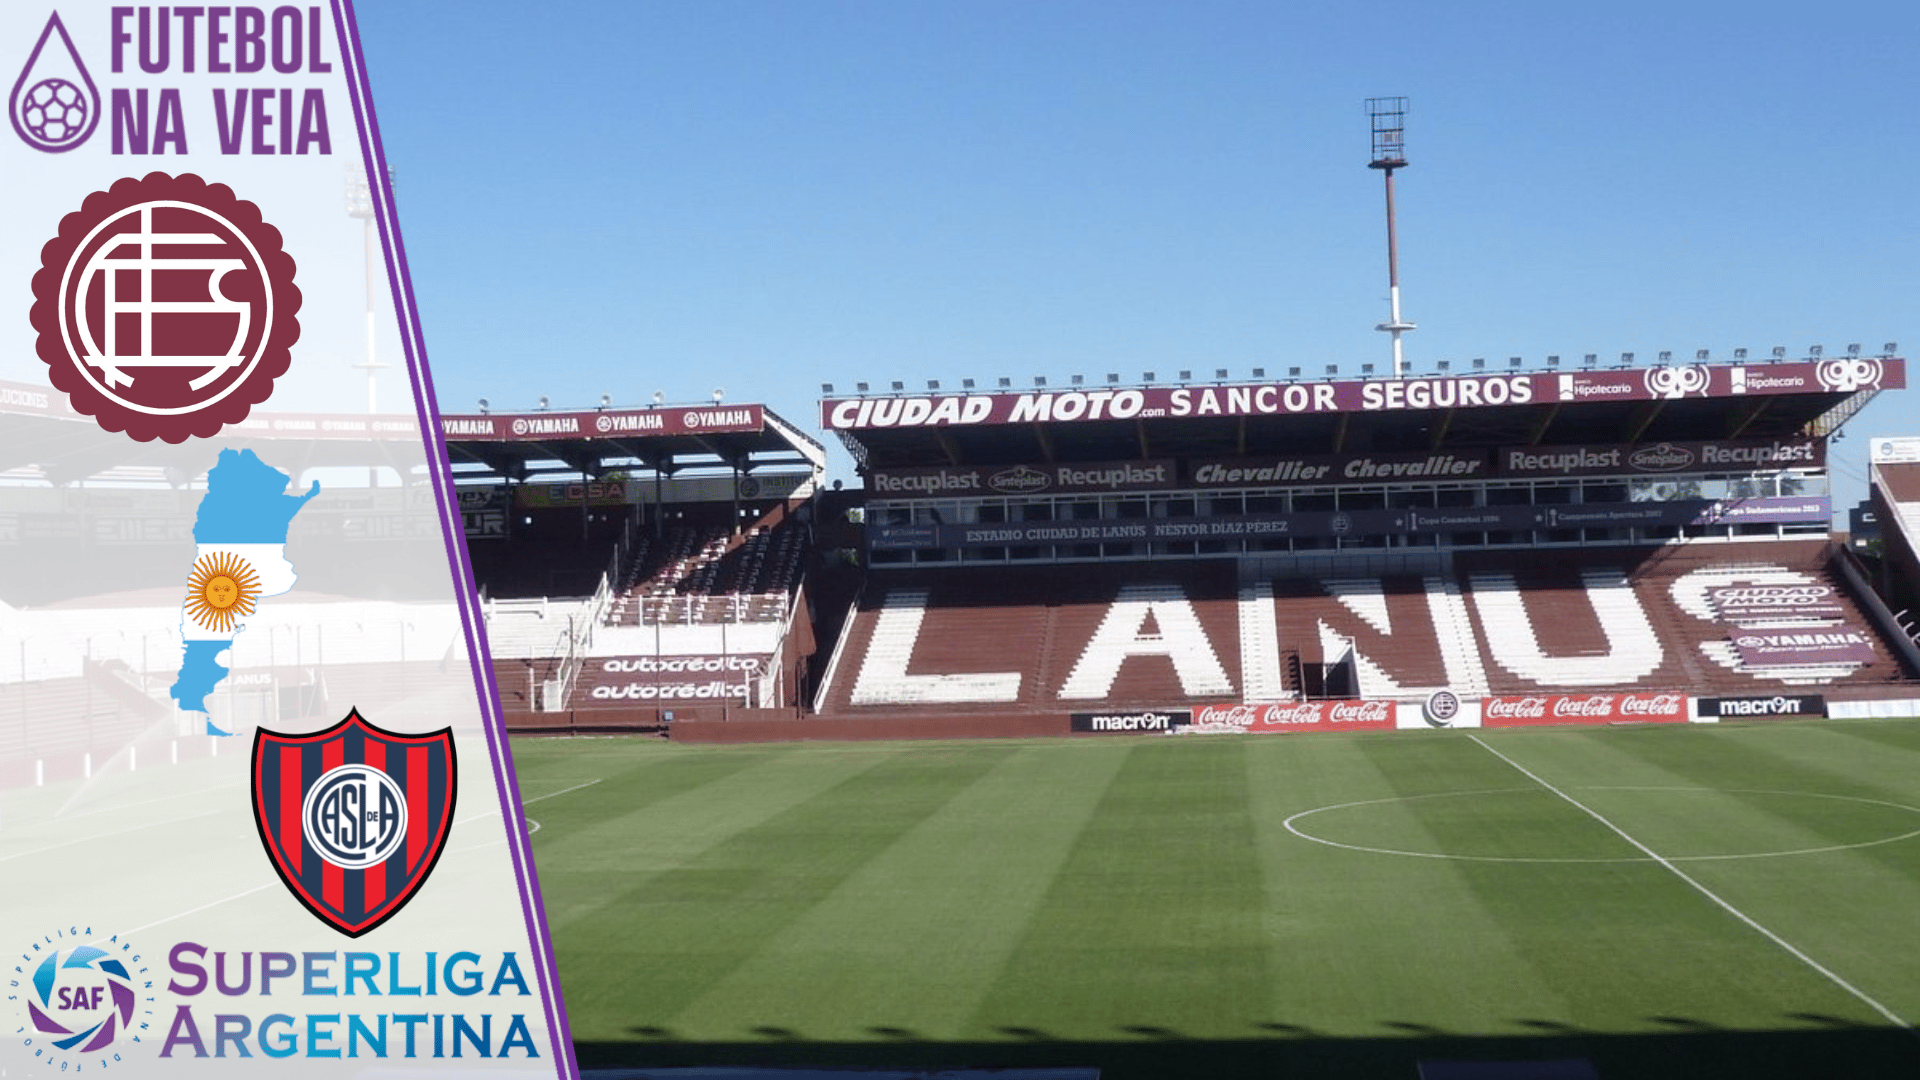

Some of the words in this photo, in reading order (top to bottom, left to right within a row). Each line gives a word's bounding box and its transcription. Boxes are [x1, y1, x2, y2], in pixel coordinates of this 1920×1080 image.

[1170, 384, 1338, 416] SANCOR
[1362, 376, 1532, 409] SEGUROS
[698, 411, 752, 427] YAMAHA
[830, 397, 993, 428] CIUDAD
[527, 418, 580, 434] YAMAHA
[612, 415, 664, 431] YAMAHA
[1509, 448, 1621, 473] Recuplast
[1702, 442, 1814, 472] Recuplast
[1057, 464, 1166, 488] Recuplast
[1195, 461, 1331, 484] Chevallier
[1344, 456, 1482, 479] Chevallier
[874, 470, 981, 494] Recuplast
[966, 529, 1023, 542] ESTADIO
[1026, 527, 1078, 541] CIUDAD
[1082, 526, 1099, 539] DE
[1714, 586, 1830, 600] CIUDAD
[1720, 597, 1818, 607] MOTO
[1764, 634, 1864, 647] YAMAHA
[1719, 696, 1801, 715] macron
[1092, 713, 1171, 730] macron
